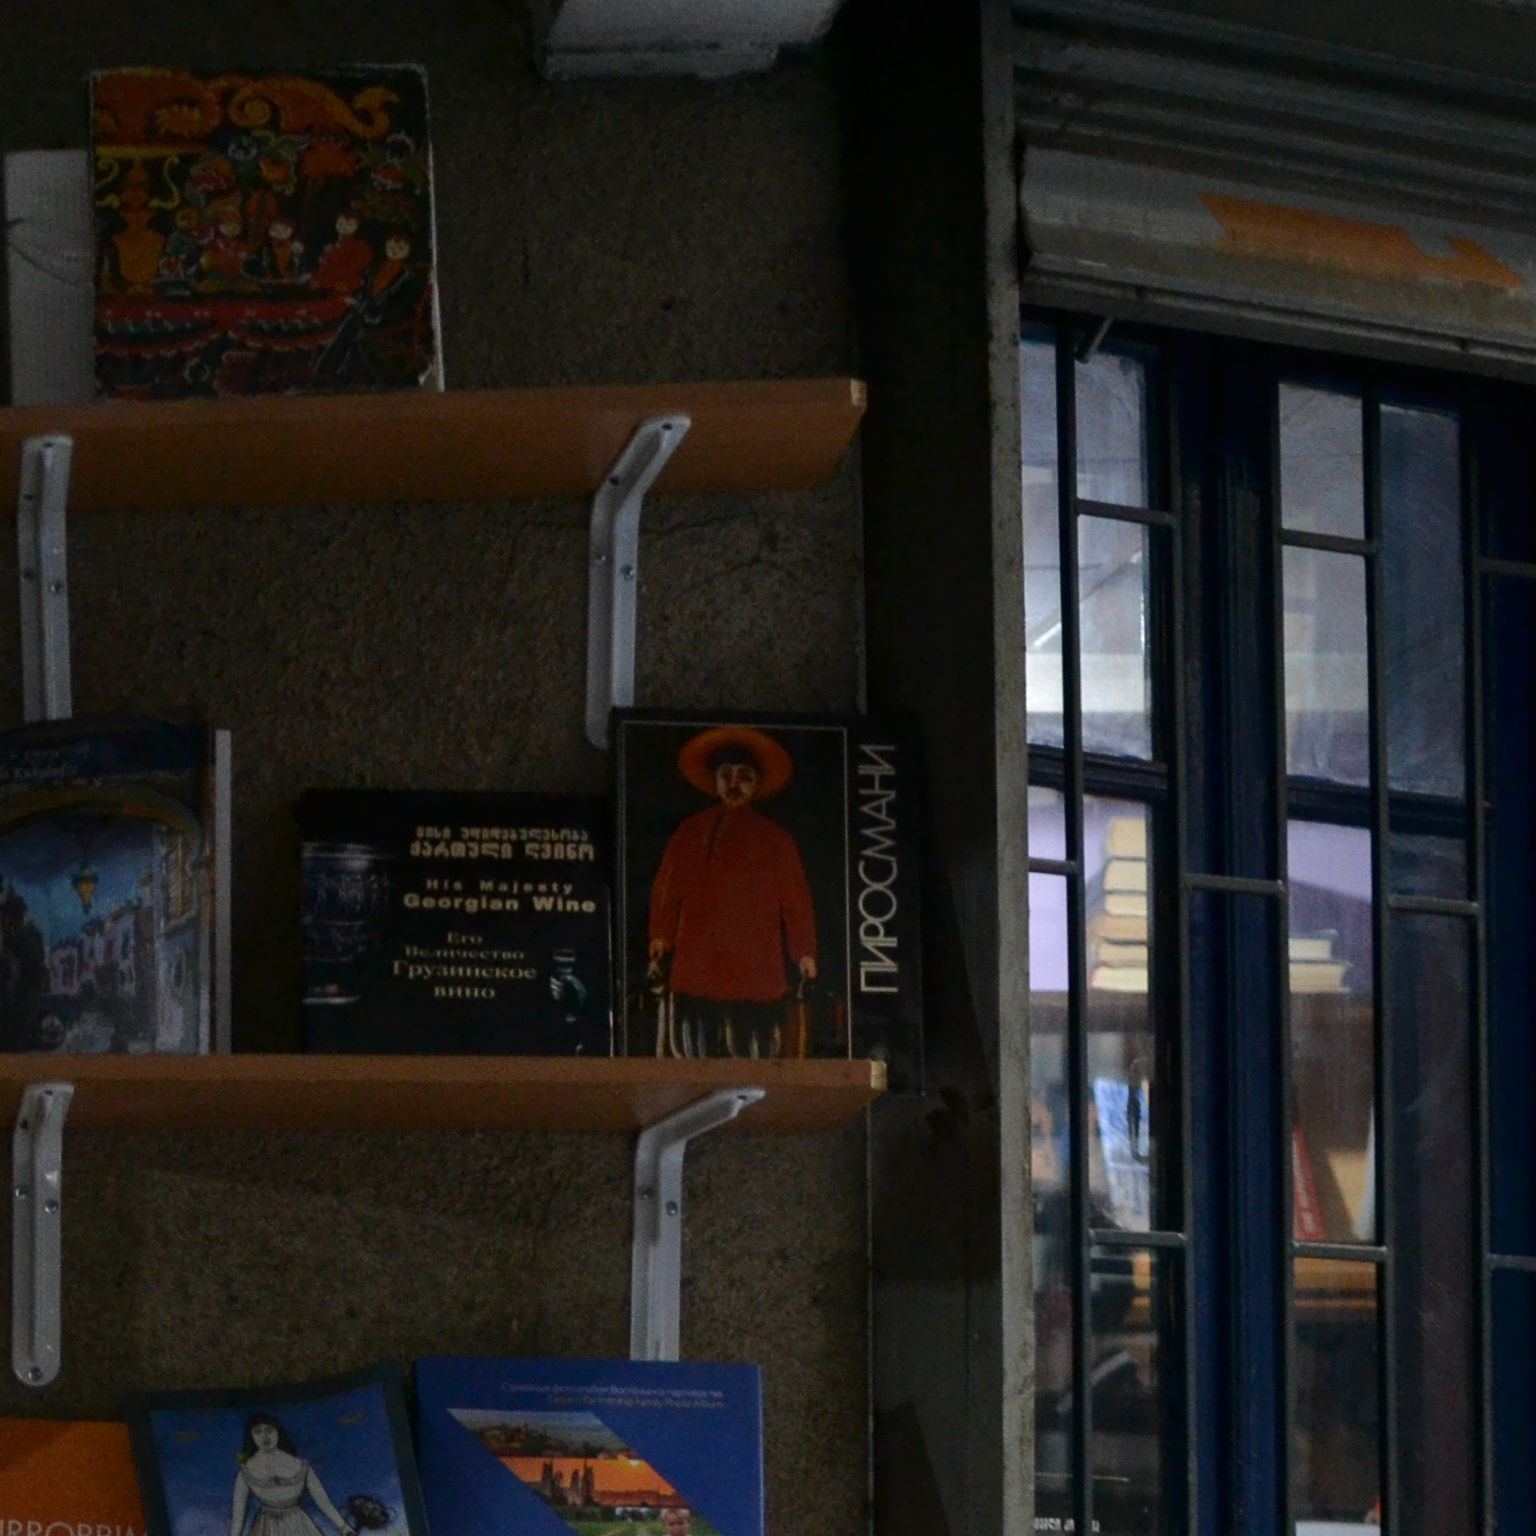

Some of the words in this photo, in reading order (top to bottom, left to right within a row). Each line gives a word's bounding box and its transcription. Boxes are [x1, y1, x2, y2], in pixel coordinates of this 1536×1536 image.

[409, 841, 514, 860] ქართული
[524, 842, 596, 862] ღვინო
[857, 743, 899, 994] ПИРОСМАНИ
[425, 878, 464, 891] His
[479, 878, 574, 895] Majesty
[402, 891, 520, 914] Georgian
[532, 895, 598, 912] Wine
[446, 930, 483, 945] Его
[391, 959, 538, 981] Грузинское
[433, 985, 497, 1000] вино
